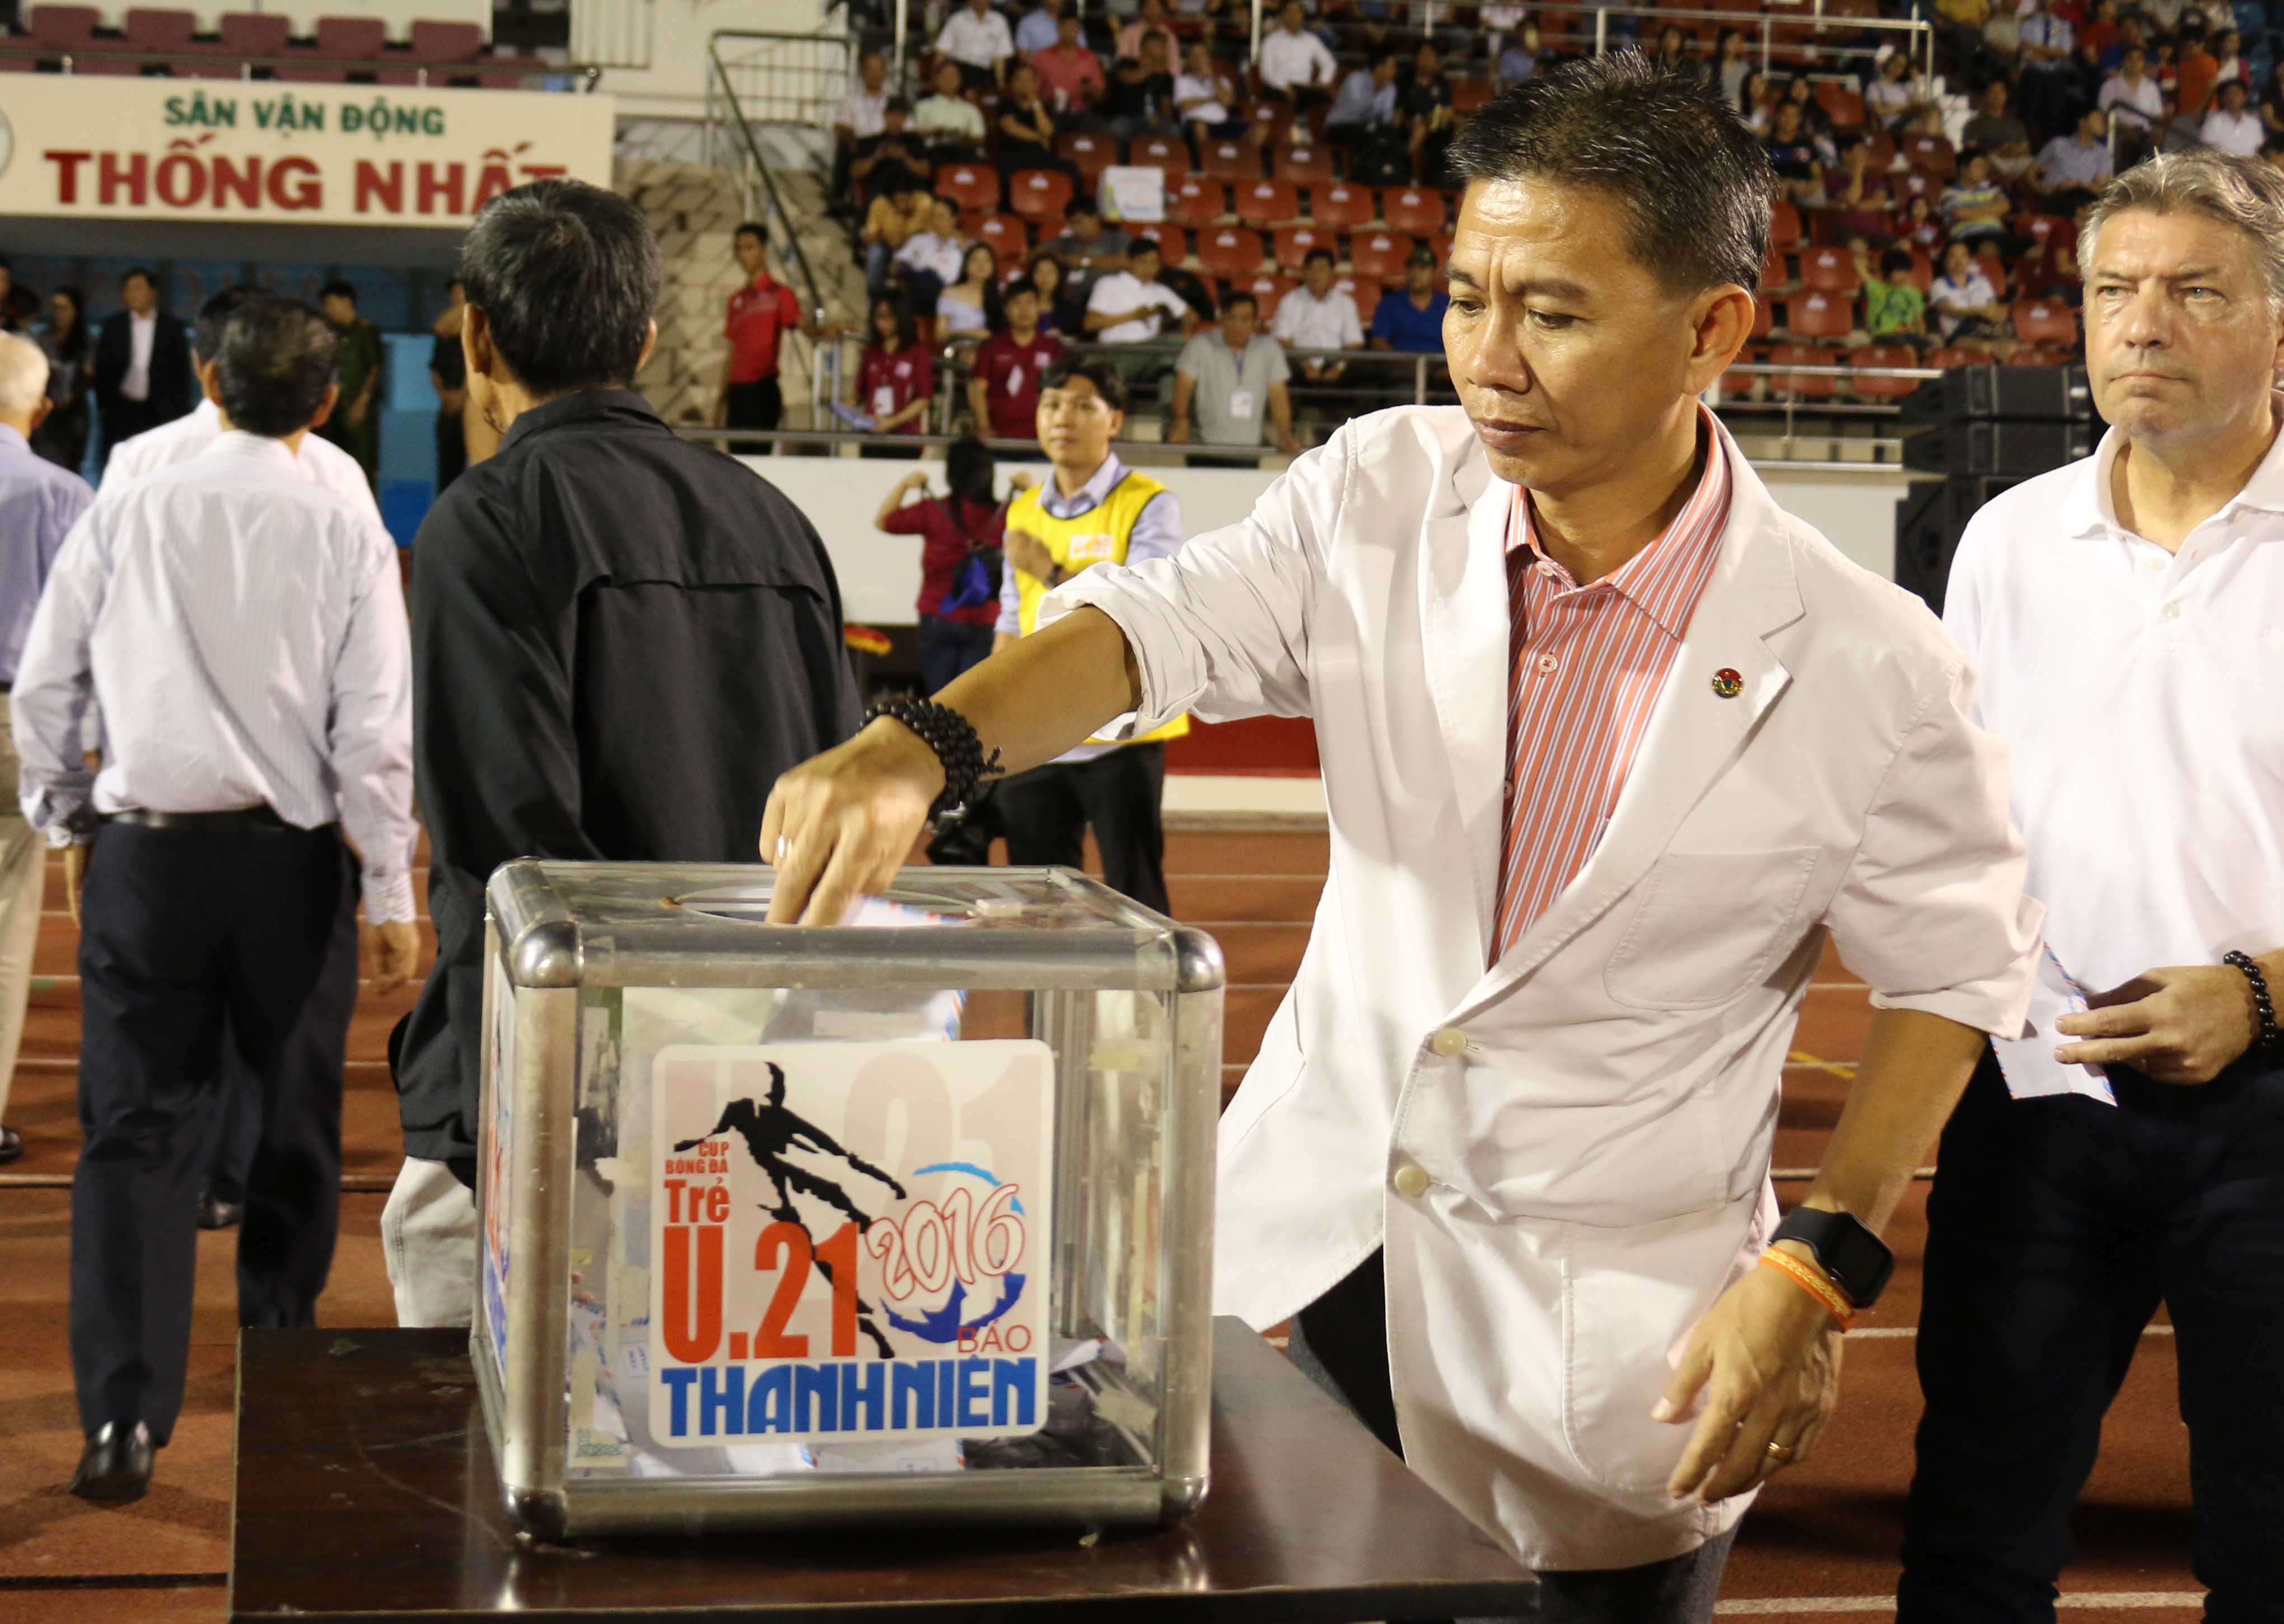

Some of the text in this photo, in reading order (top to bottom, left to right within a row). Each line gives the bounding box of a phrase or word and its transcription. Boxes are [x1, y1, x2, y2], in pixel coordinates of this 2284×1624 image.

[164, 90, 445, 141] SÂN VẬN ĐỘNG
[44, 134, 323, 210] THỐNG
[664, 1177, 730, 1223] Trẻ
[865, 1183, 1026, 1301] 2016
[663, 1221, 860, 1364] U.21
[957, 1319, 1031, 1353] BÁO
